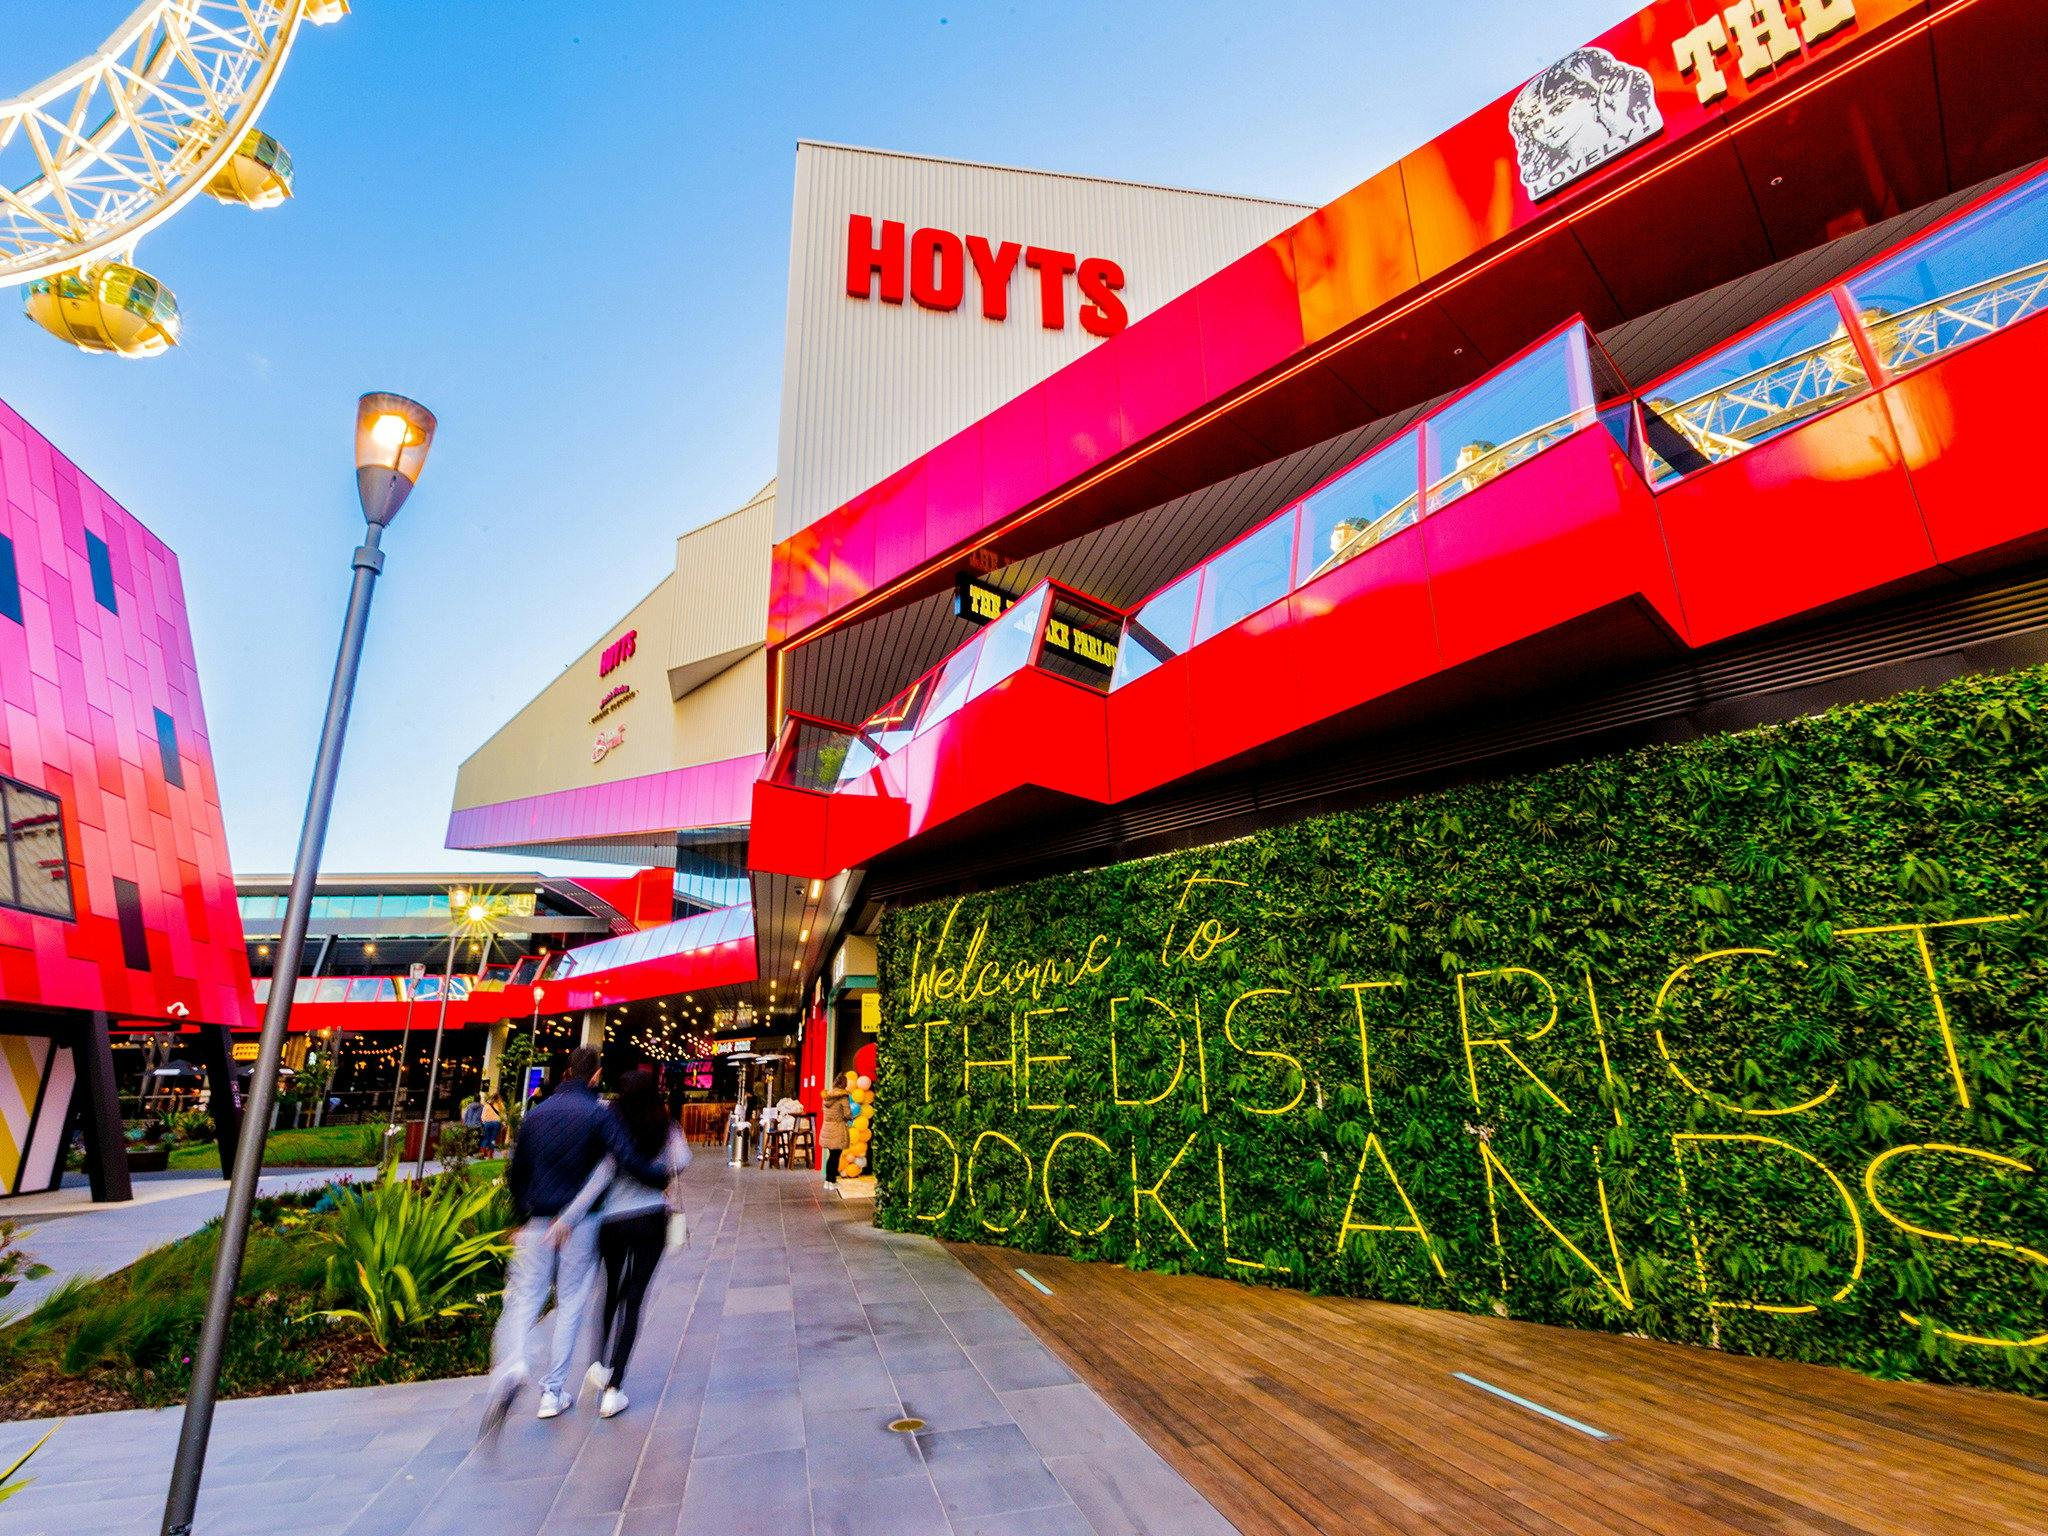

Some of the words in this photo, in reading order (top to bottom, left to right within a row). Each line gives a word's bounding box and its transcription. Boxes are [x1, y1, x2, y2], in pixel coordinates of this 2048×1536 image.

[1533, 110, 1651, 197] LOVELY!
[846, 213, 1129, 338] HOYTS
[969, 584, 1001, 619] THE
[908, 896, 1120, 1016] Welcome
[1163, 870, 1249, 968] to
[904, 1006, 1077, 1114] THE
[1110, 913, 2024, 1128] DISTRICT
[907, 1123, 2048, 1346] DOCKLANDS
